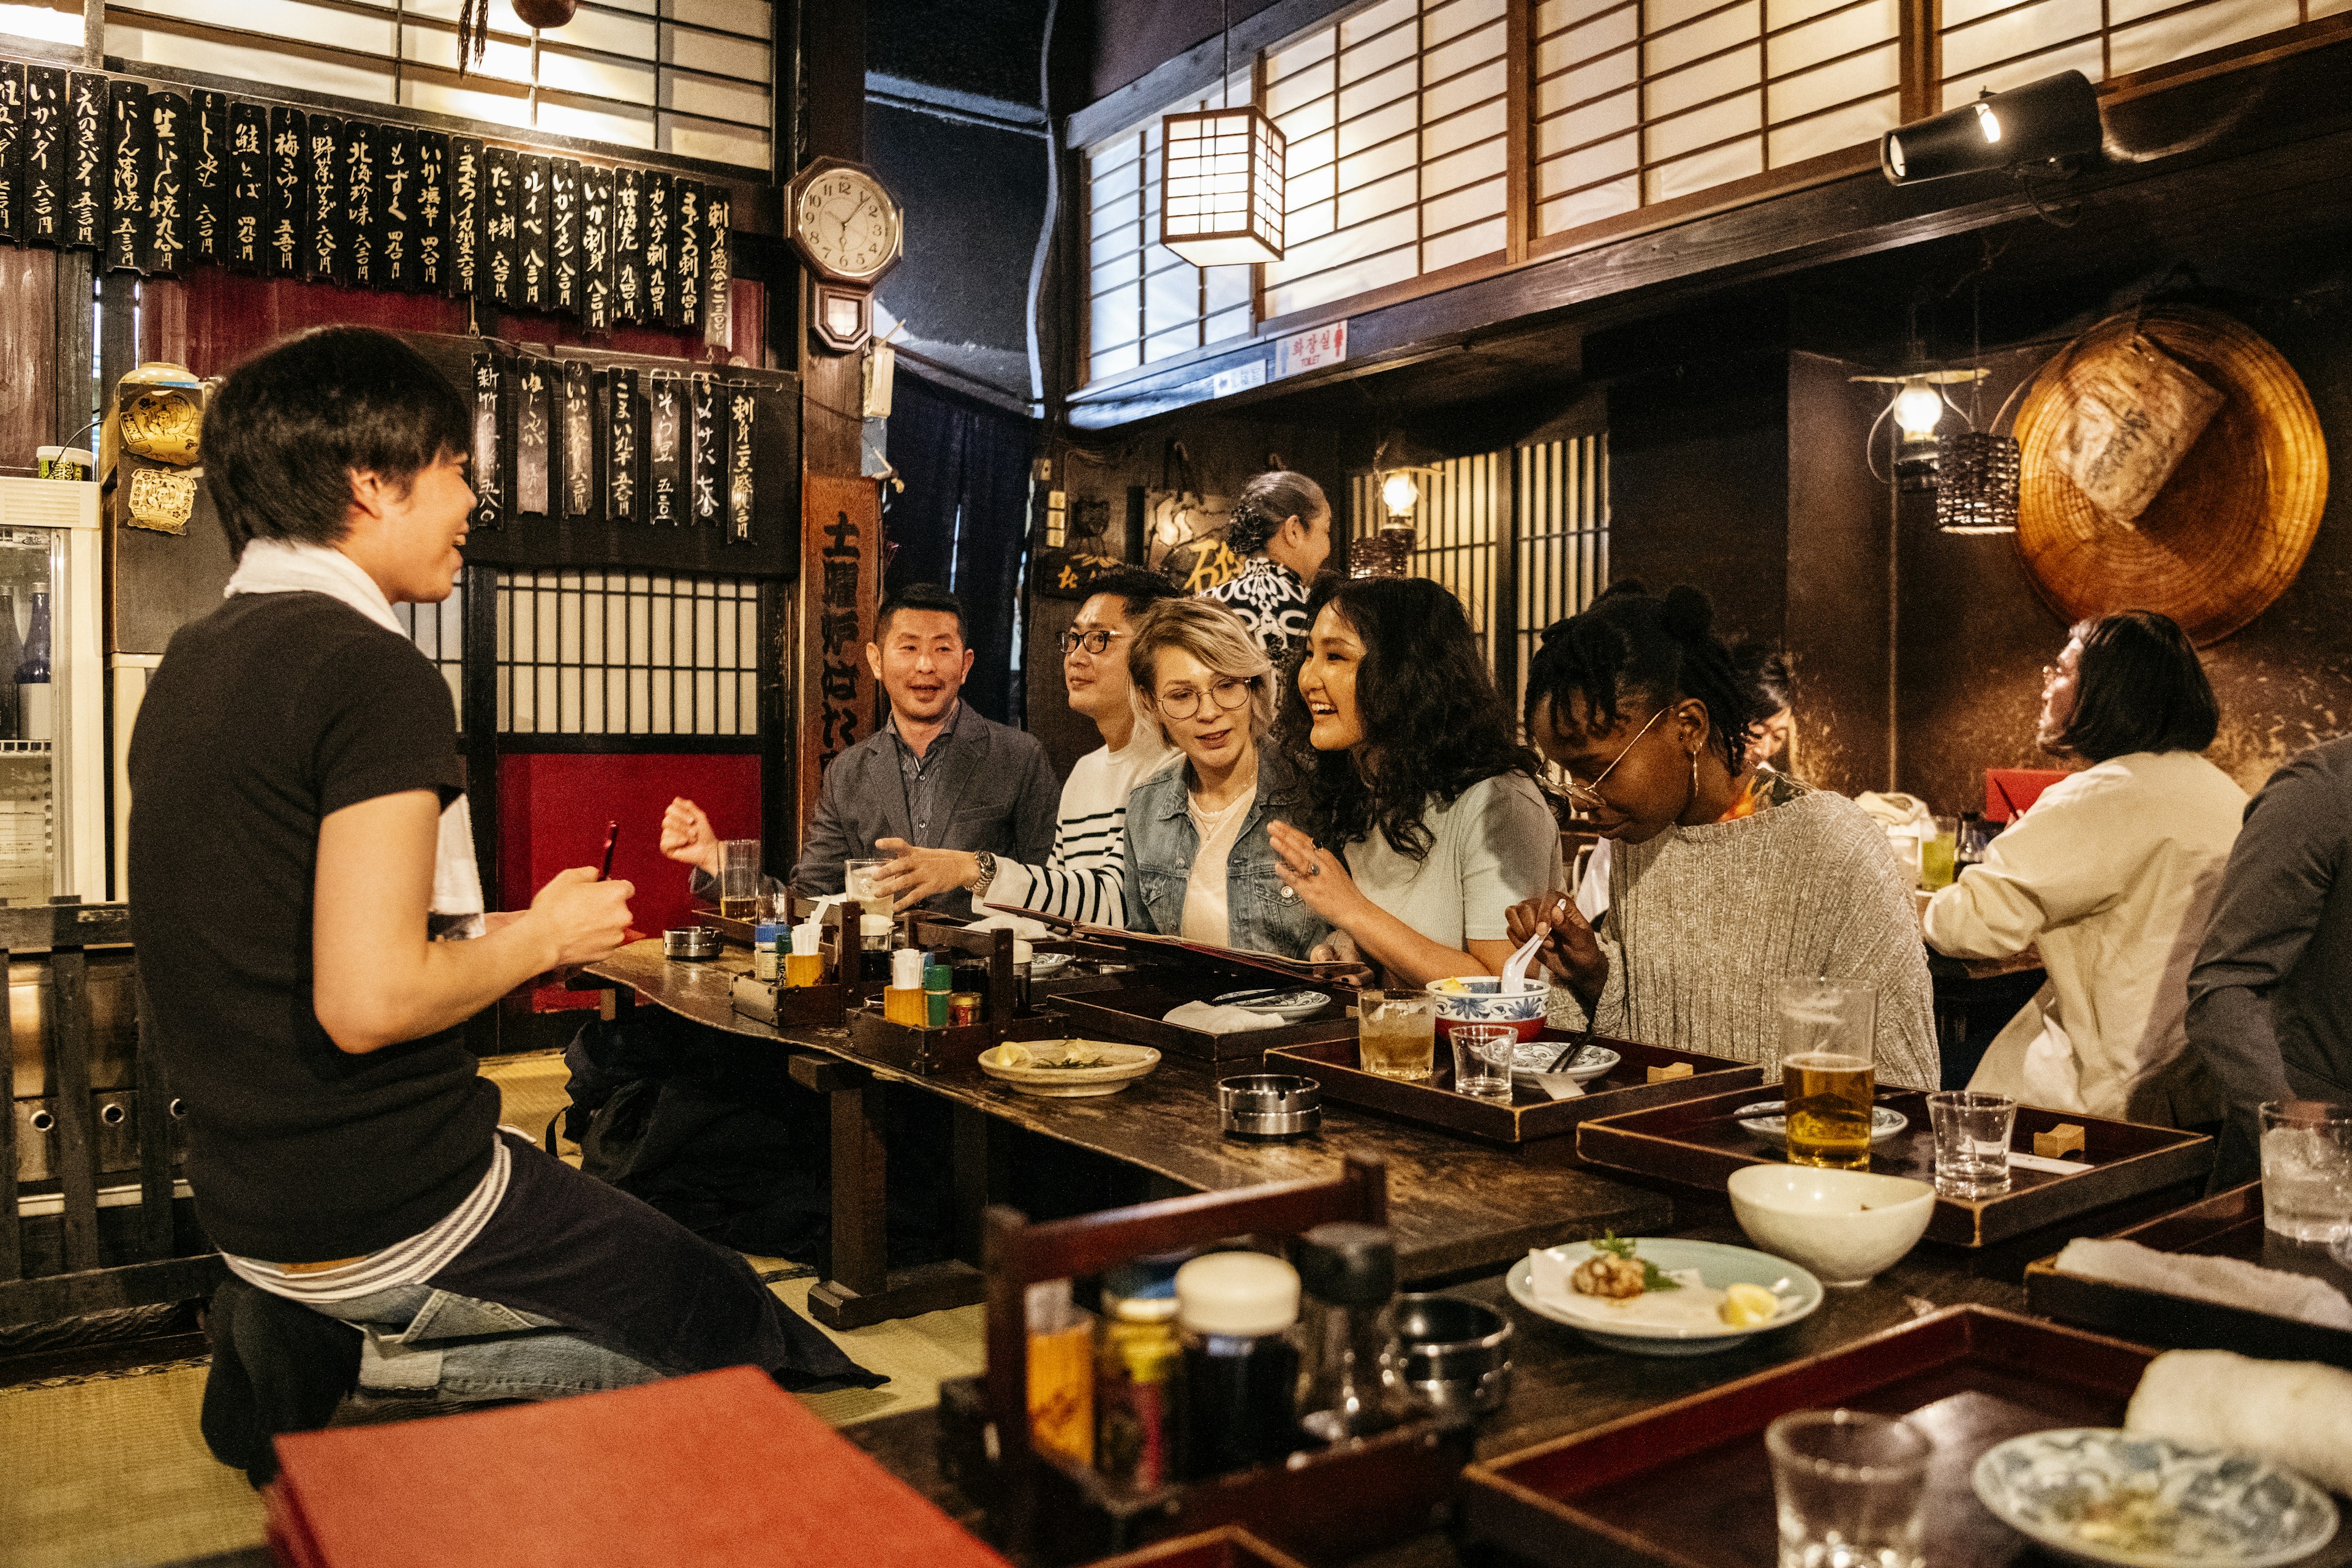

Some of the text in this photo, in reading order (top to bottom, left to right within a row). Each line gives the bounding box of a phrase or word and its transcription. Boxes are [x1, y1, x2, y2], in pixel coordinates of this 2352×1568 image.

[824, 184, 832, 197] 11
[839, 182, 851, 195] 12
[809, 194, 821, 208] 10
[868, 205, 878, 218] 2
[805, 212, 815, 225] 9
[872, 224, 882, 236] 3
[810, 231, 820, 244] 8
[822, 246, 832, 259] 7
[869, 243, 878, 254] 4
[839, 255, 848, 267] 6
[856, 252, 865, 265] 5
[1292, 330, 1330, 356] 화장실
